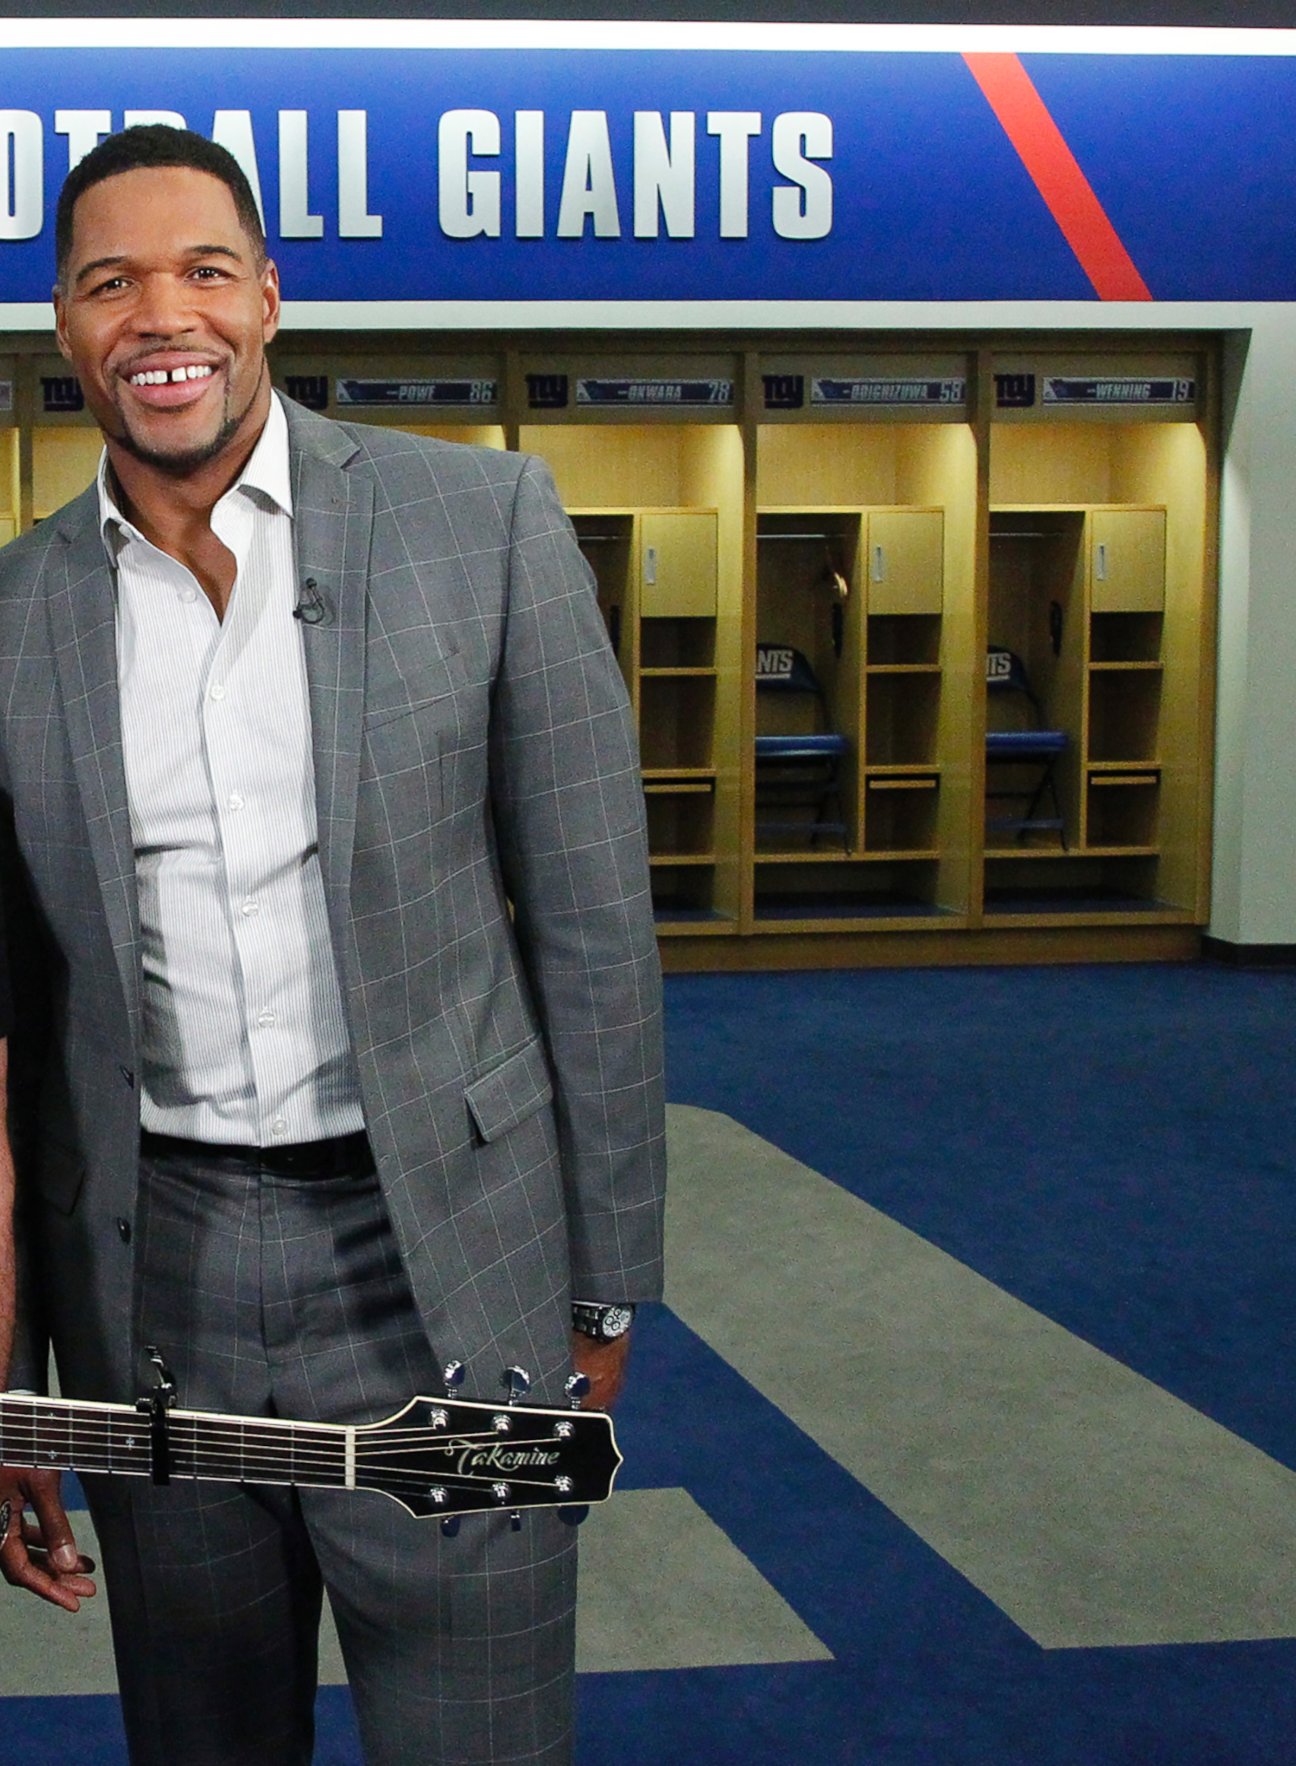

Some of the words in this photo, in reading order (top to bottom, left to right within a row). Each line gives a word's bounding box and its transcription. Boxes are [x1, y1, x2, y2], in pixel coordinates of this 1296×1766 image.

[437, 108, 835, 241] GIANTS
[470, 382, 493, 402] 86
[708, 381, 731, 402] 78
[940, 381, 962, 402] 58
[1172, 380, 1190, 401] 19
[444, 1438, 561, 1477] Takamine
